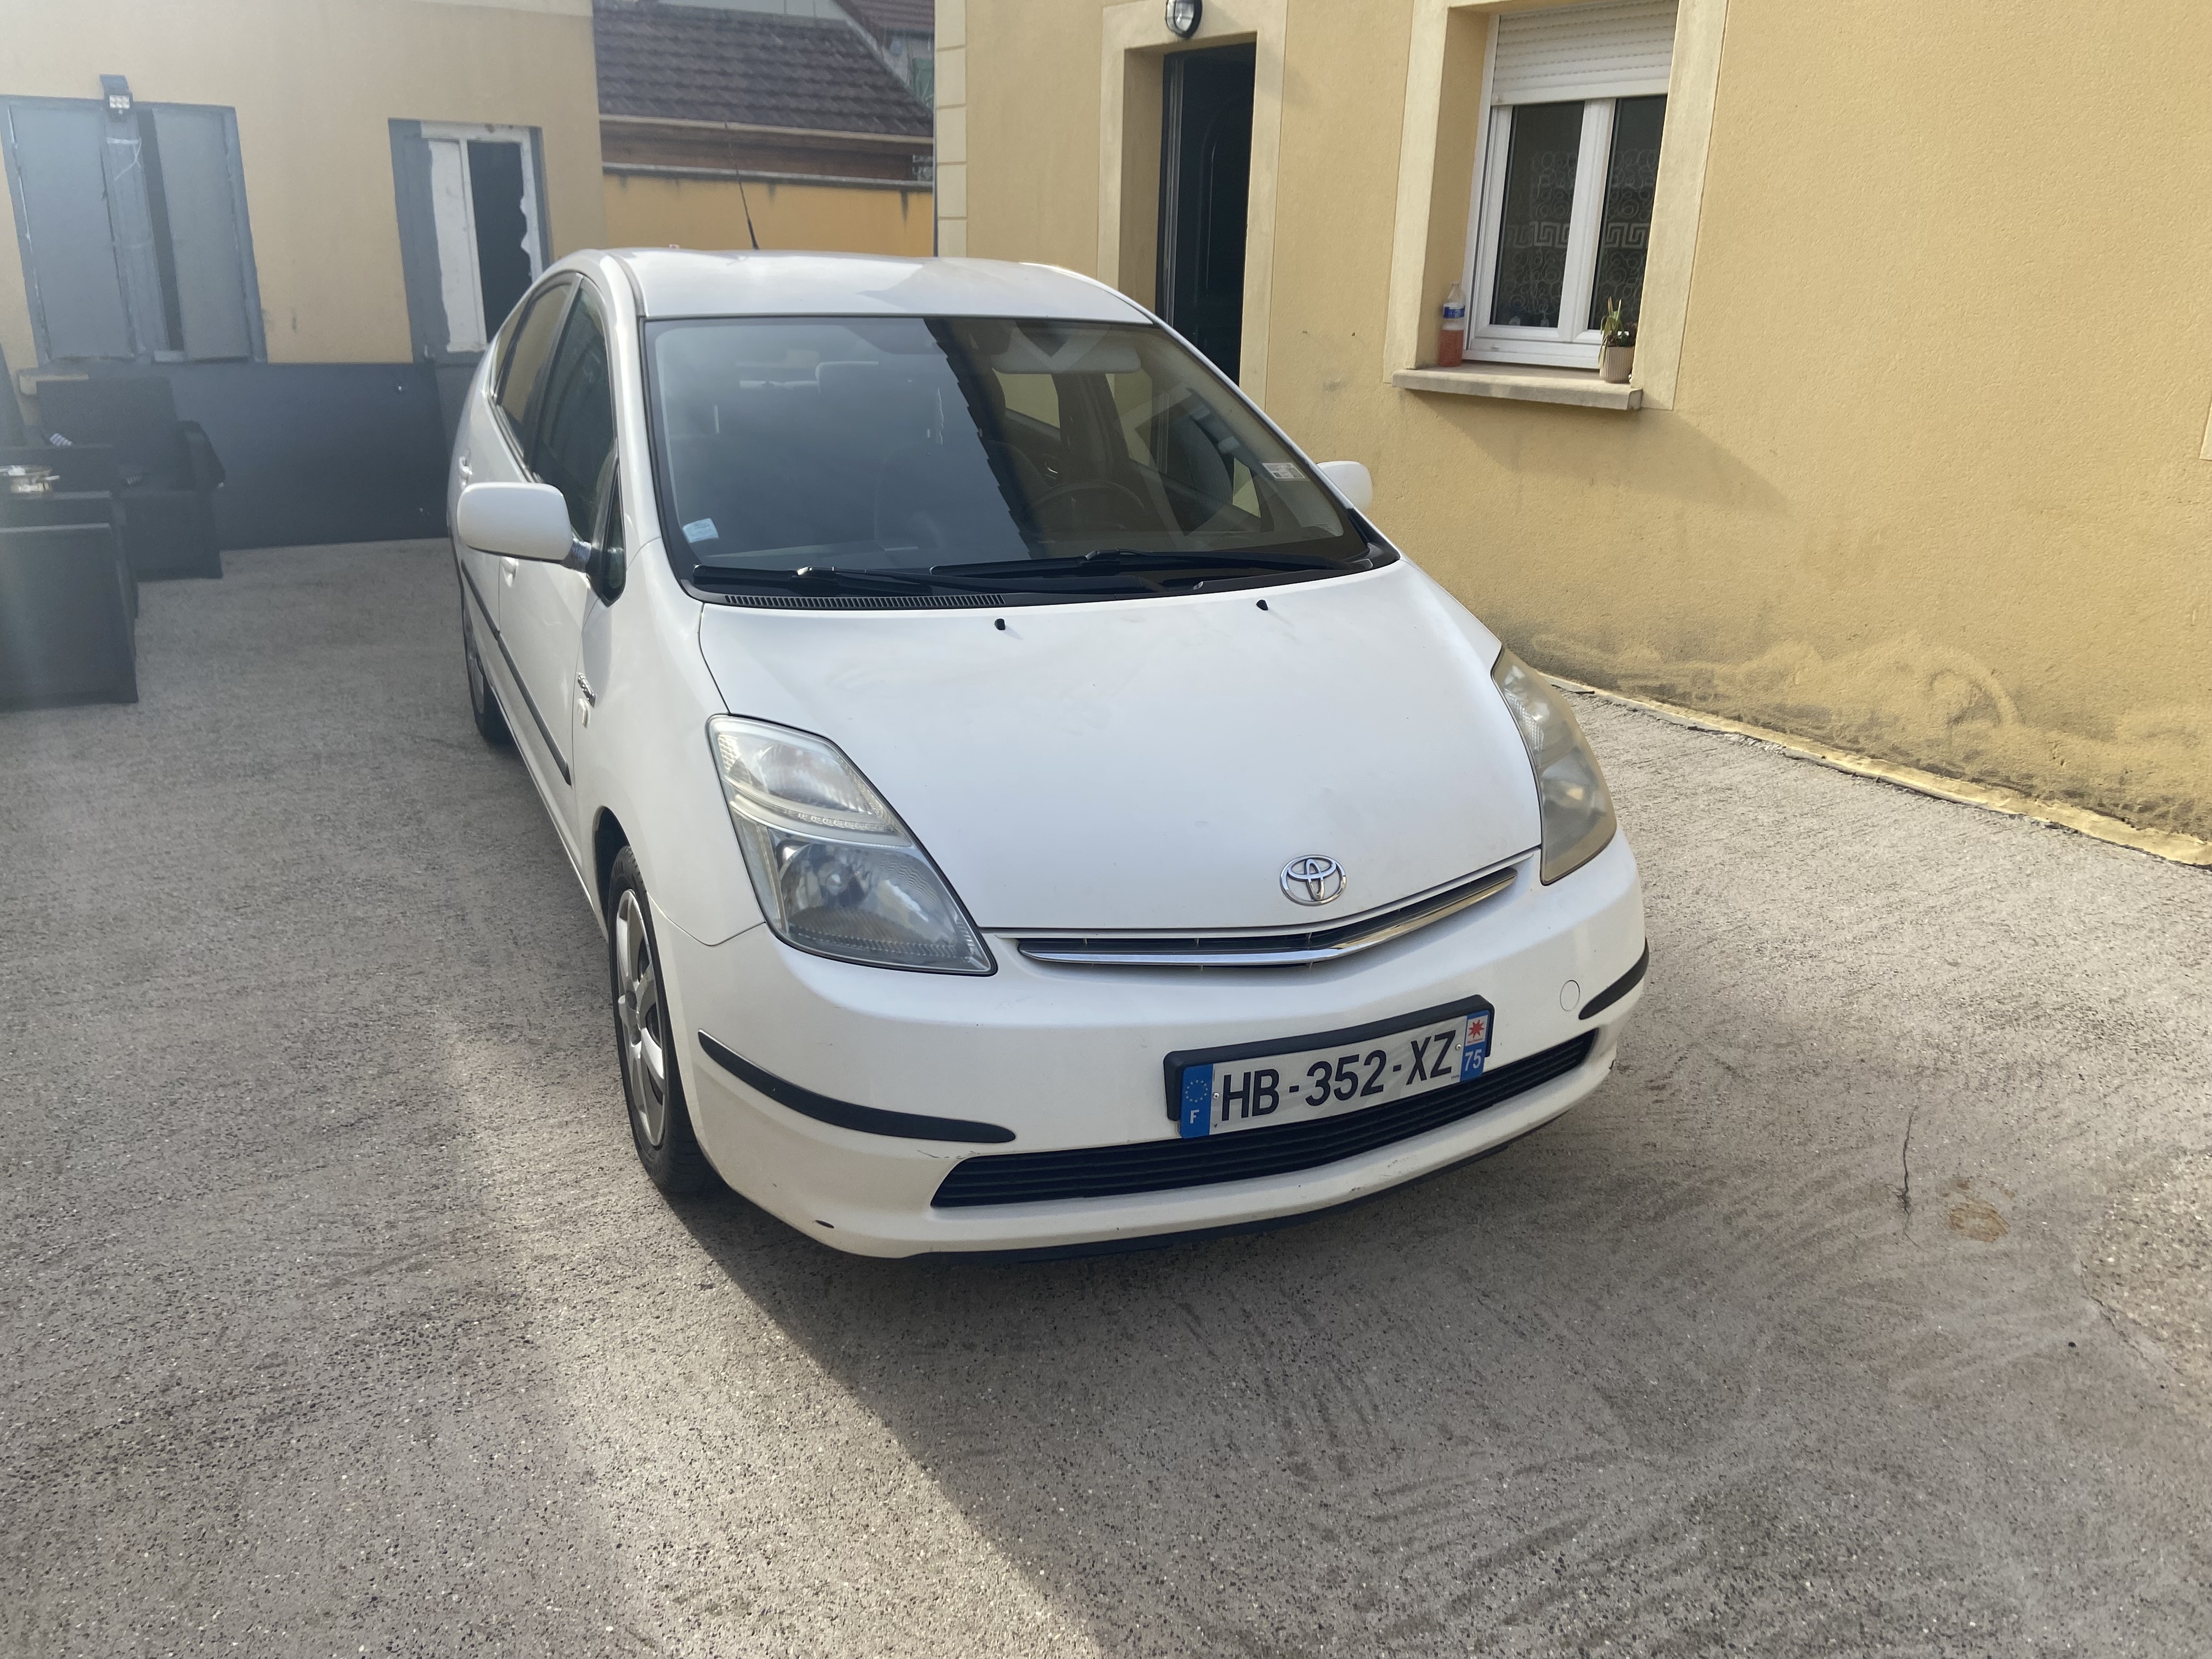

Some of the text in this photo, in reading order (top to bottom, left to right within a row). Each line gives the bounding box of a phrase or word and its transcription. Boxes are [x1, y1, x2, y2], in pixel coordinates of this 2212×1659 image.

[1465, 1048, 1482, 1071] 75
[1221, 1030, 1456, 1121] HB-352-XZ
[1190, 1109, 1199, 1124] F
